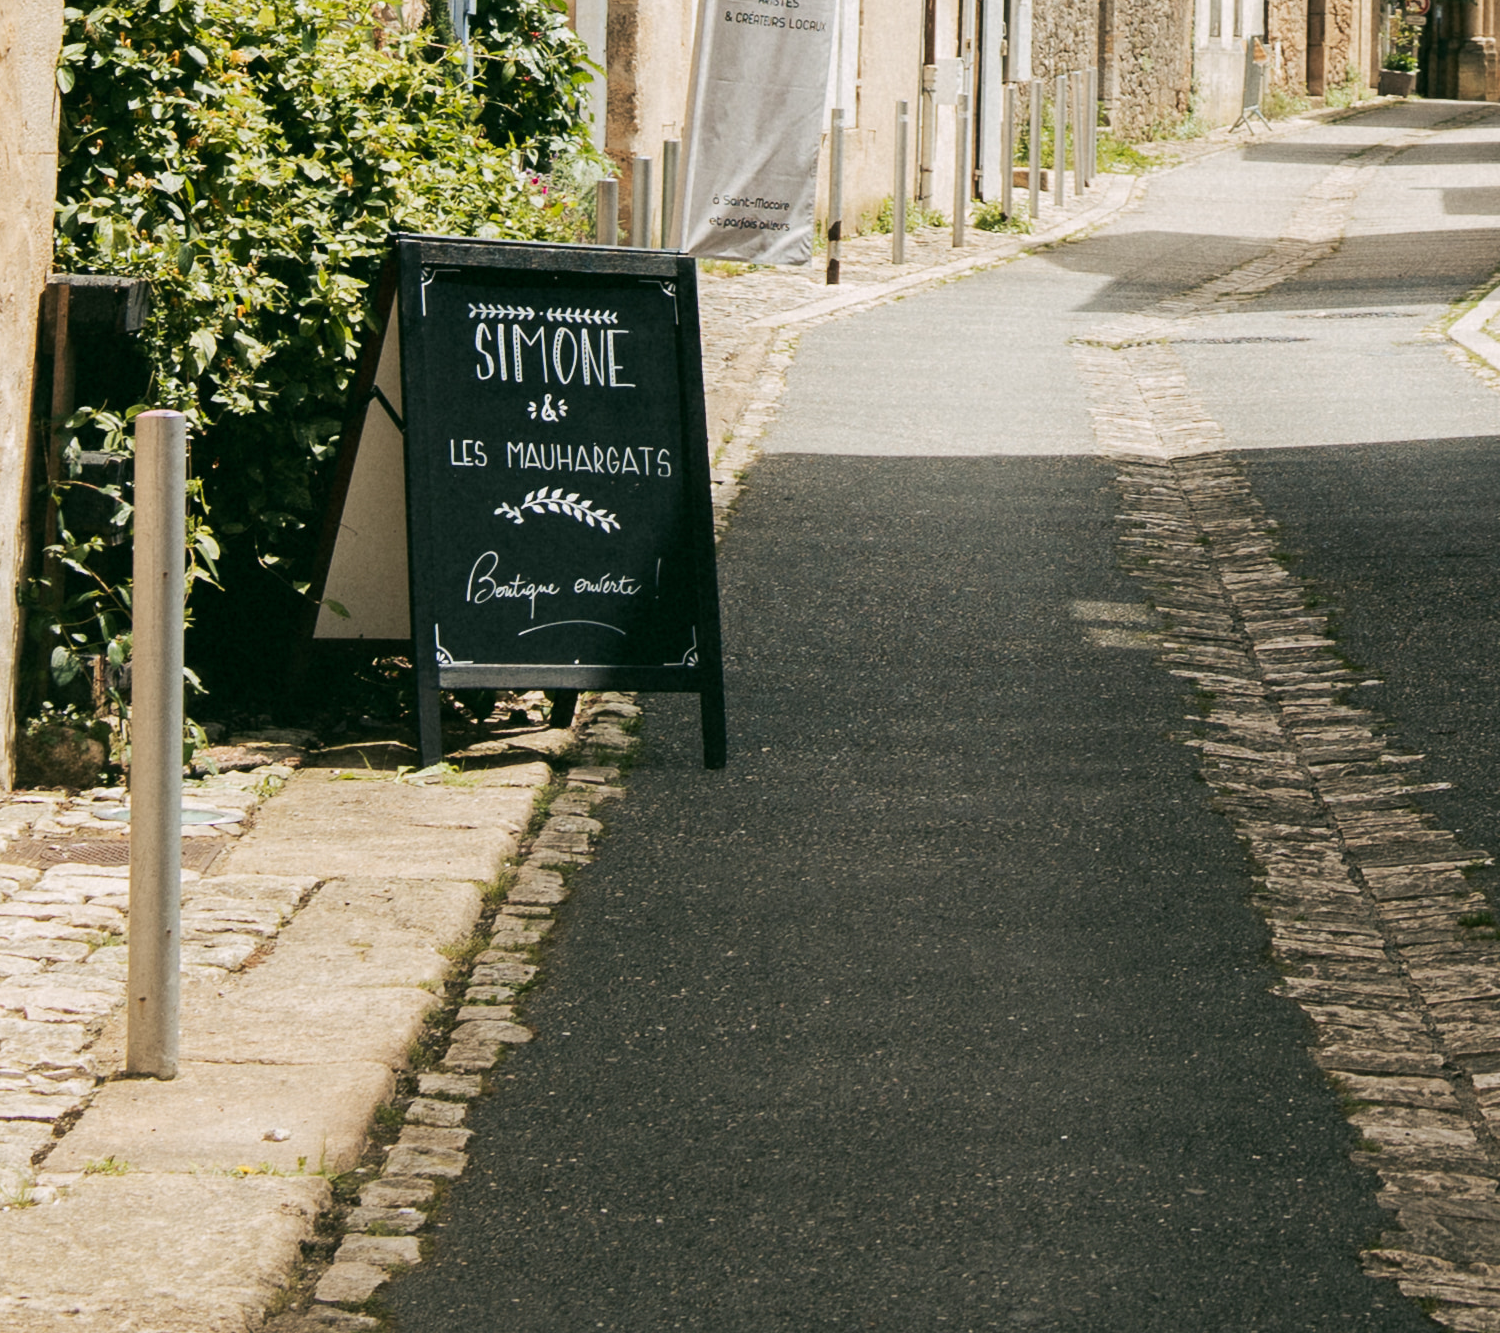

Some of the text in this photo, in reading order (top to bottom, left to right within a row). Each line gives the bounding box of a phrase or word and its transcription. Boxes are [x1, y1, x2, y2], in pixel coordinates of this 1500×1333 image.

[724, 10, 732, 22] &
[788, 18, 827, 32] LOCAUX
[709, 216, 722, 226] et
[723, 217, 758, 229] parfois
[475, 322, 636, 387] SIMONE
[541, 393, 559, 422] &
[450, 439, 672, 477] LES MAUHARGATS
[466, 550, 560, 619] Boutique
[574, 573, 641, 595] ouverte
